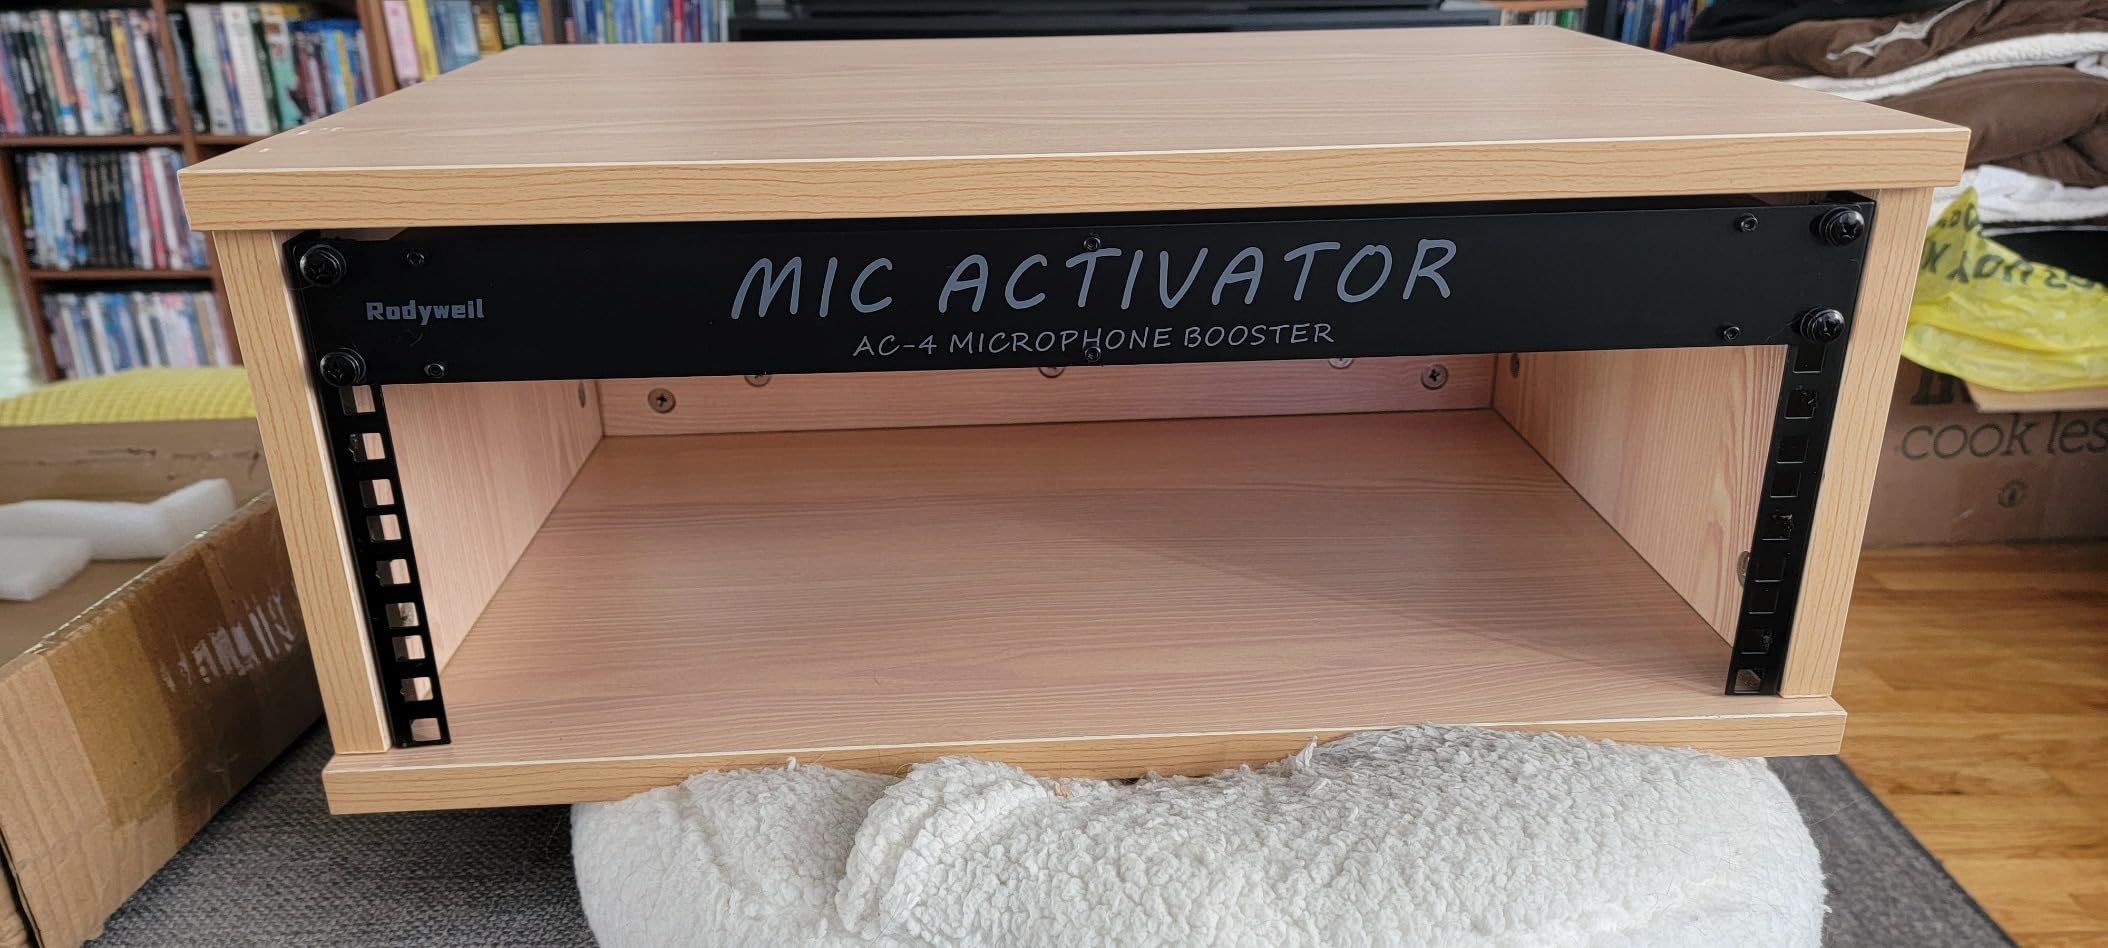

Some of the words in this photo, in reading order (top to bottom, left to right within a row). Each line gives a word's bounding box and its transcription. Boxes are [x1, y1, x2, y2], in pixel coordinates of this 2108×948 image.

[731, 256, 893, 320] MIC
[938, 238, 1457, 314] ACTIVATOR
[366, 298, 484, 326] Rodyweil
[852, 334, 938, 357] AC-4
[949, 326, 1173, 354] MICROPHONE
[1183, 322, 1334, 348] BOOSTER
[1901, 412, 2039, 461] cook
